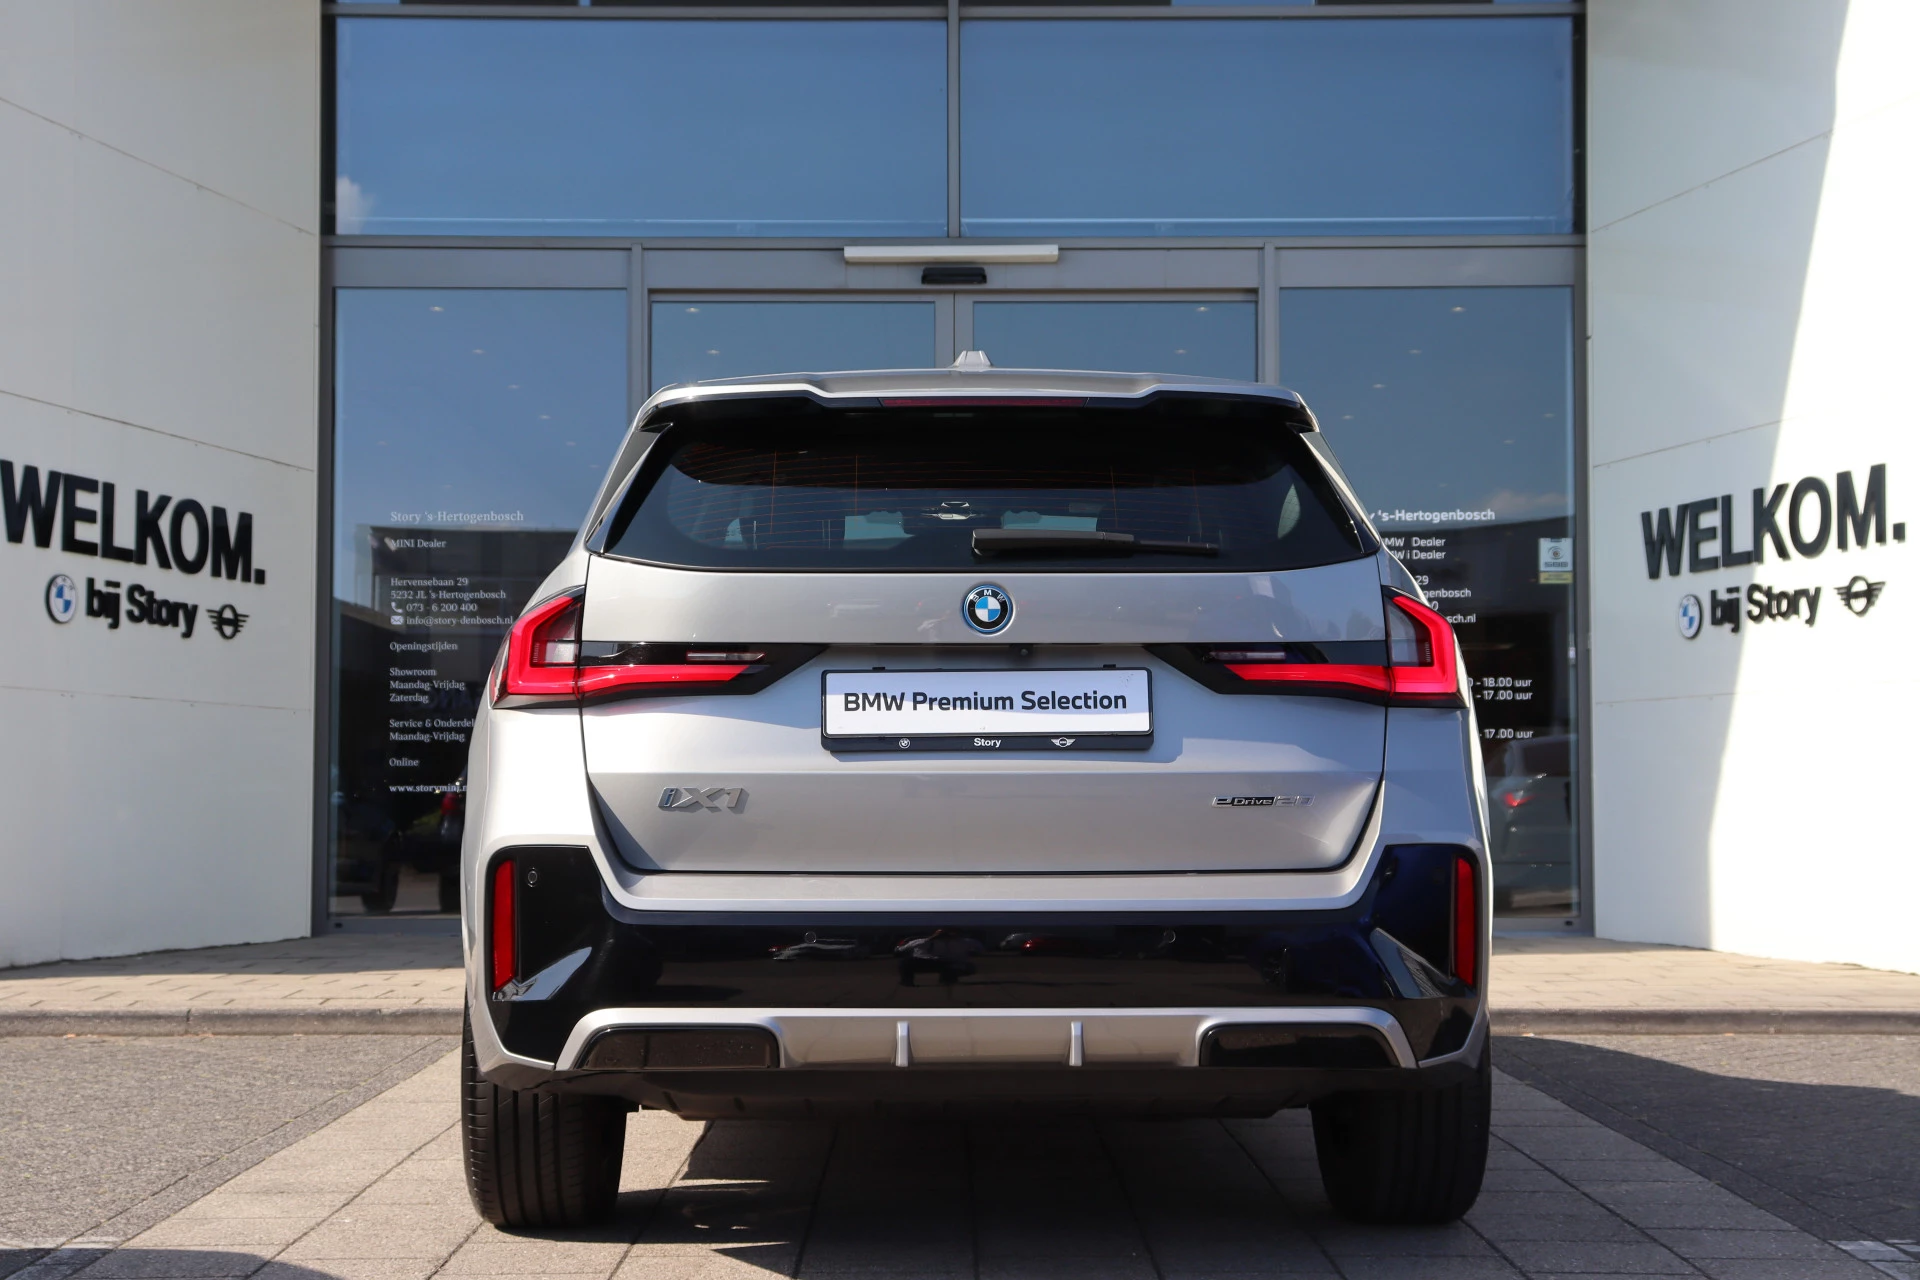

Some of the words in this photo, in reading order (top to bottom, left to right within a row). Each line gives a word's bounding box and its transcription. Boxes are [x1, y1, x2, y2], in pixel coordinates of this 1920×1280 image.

[0, 459, 266, 585] WELKOM.
[390, 511, 421, 524] Story
[1640, 463, 1906, 580] WELKOM.
[390, 539, 415, 548] MINI
[417, 539, 447, 548] Dealer
[1411, 537, 1446, 547] Dealer
[1411, 550, 1446, 559] Dealer
[390, 577, 454, 586] Hervensebaan
[456, 577, 469, 586] 29
[1415, 575, 1429, 585] 29
[390, 590, 413, 599] 5232
[415, 590, 427, 599] JL
[971, 589, 1006, 603] BMW
[85, 577, 121, 630] bij
[126, 583, 198, 639] Story
[406, 603, 424, 612] 073
[431, 603, 439, 612] 6
[440, 603, 458, 612] 200
[459, 603, 478, 612] 400
[1710, 586, 1741, 633] bij
[1746, 583, 1822, 628] Story
[406, 615, 513, 627] info@story-denbosch.nl
[390, 641, 458, 652] Openingstijden
[389, 667, 437, 676] Showroom
[389, 680, 465, 691] Maandag-Vrijdag
[1483, 677, 1513, 687] 18.00
[1514, 679, 1533, 687] uur
[389, 692, 430, 704] Zaterdag
[843, 691, 906, 712] BMW
[912, 690, 1014, 711] Premium
[1021, 689, 1128, 710] Selection
[1514, 692, 1533, 700] uur
[389, 718, 422, 728] Service
[425, 719, 431, 728] &
[434, 718, 475, 728] Onderdel
[389, 732, 465, 743] Maandag-Vrijdag
[1515, 731, 1534, 739] uur
[973, 737, 1002, 748] Story
[389, 758, 419, 767] Online
[389, 783, 467, 793] www.storymini.n
